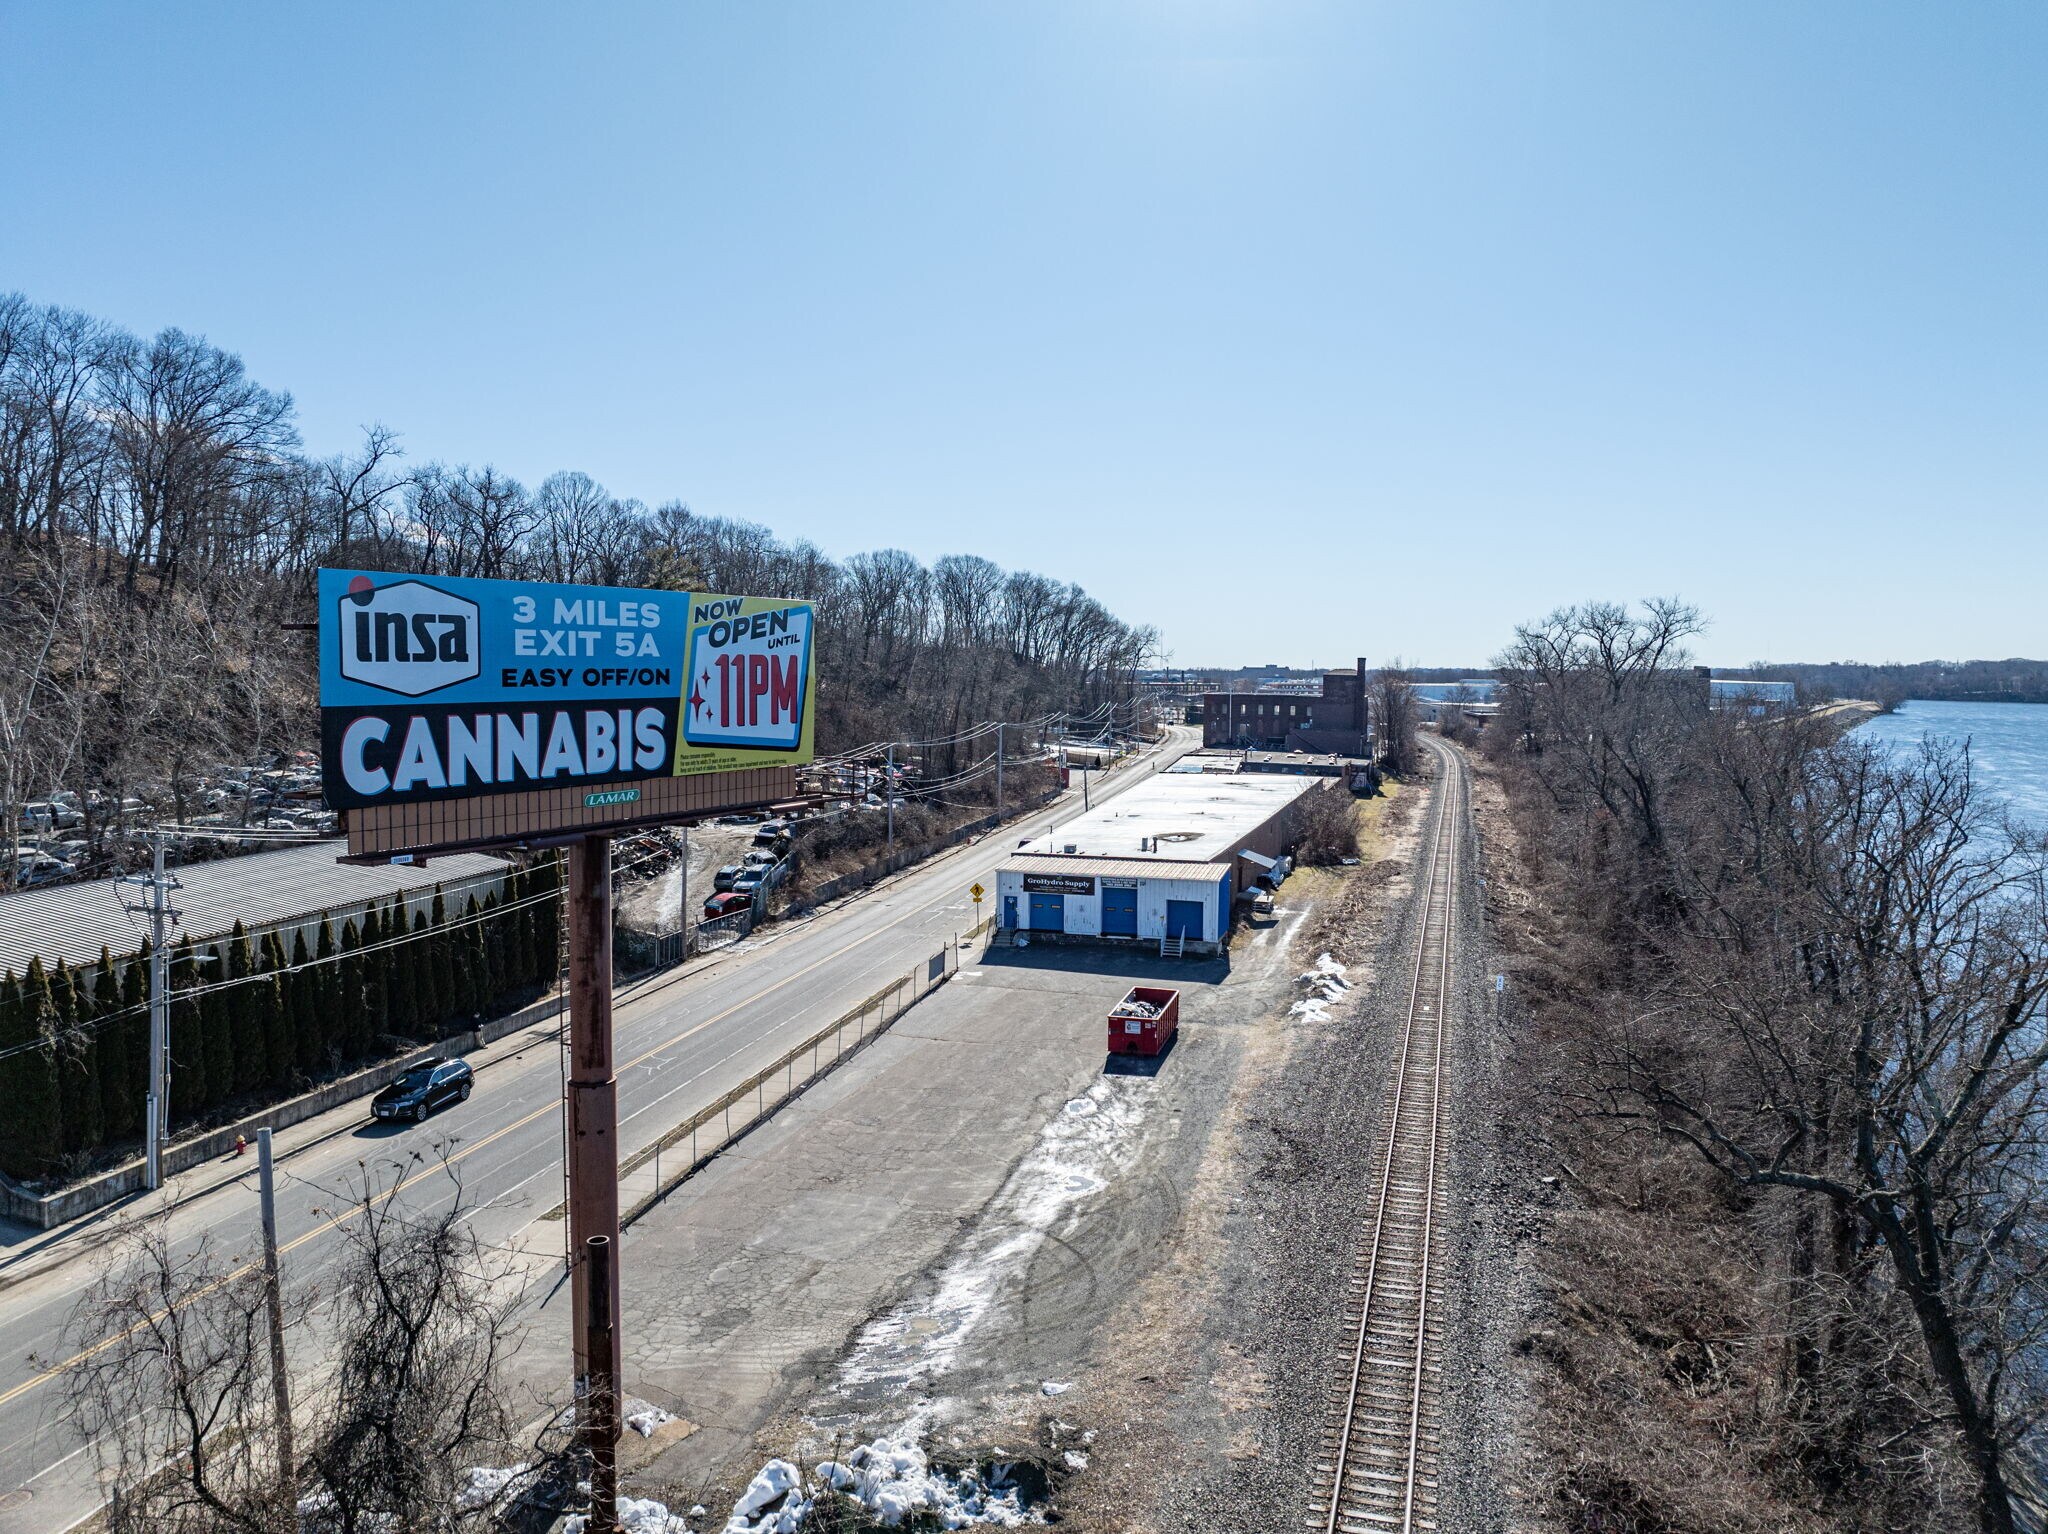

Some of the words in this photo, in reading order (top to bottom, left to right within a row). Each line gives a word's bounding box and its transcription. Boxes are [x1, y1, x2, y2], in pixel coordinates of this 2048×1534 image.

[349, 576, 469, 662] insa
[512, 596, 536, 623] 3
[553, 598, 661, 628] MILES
[694, 598, 744, 624] NOW
[708, 609, 789, 648] OPEN
[767, 634, 801, 650] UNTIL
[514, 629, 601, 657] EXIT
[615, 632, 661, 657] 5A
[501, 668, 574, 688] EASY
[582, 667, 671, 687] OFF/ON
[714, 653, 798, 728] 11PM
[340, 706, 667, 796] CANNABIS
[589, 791, 635, 806] LAMAR
[1027, 877, 1064, 887] GroHydro
[1064, 880, 1090, 889] Supply
